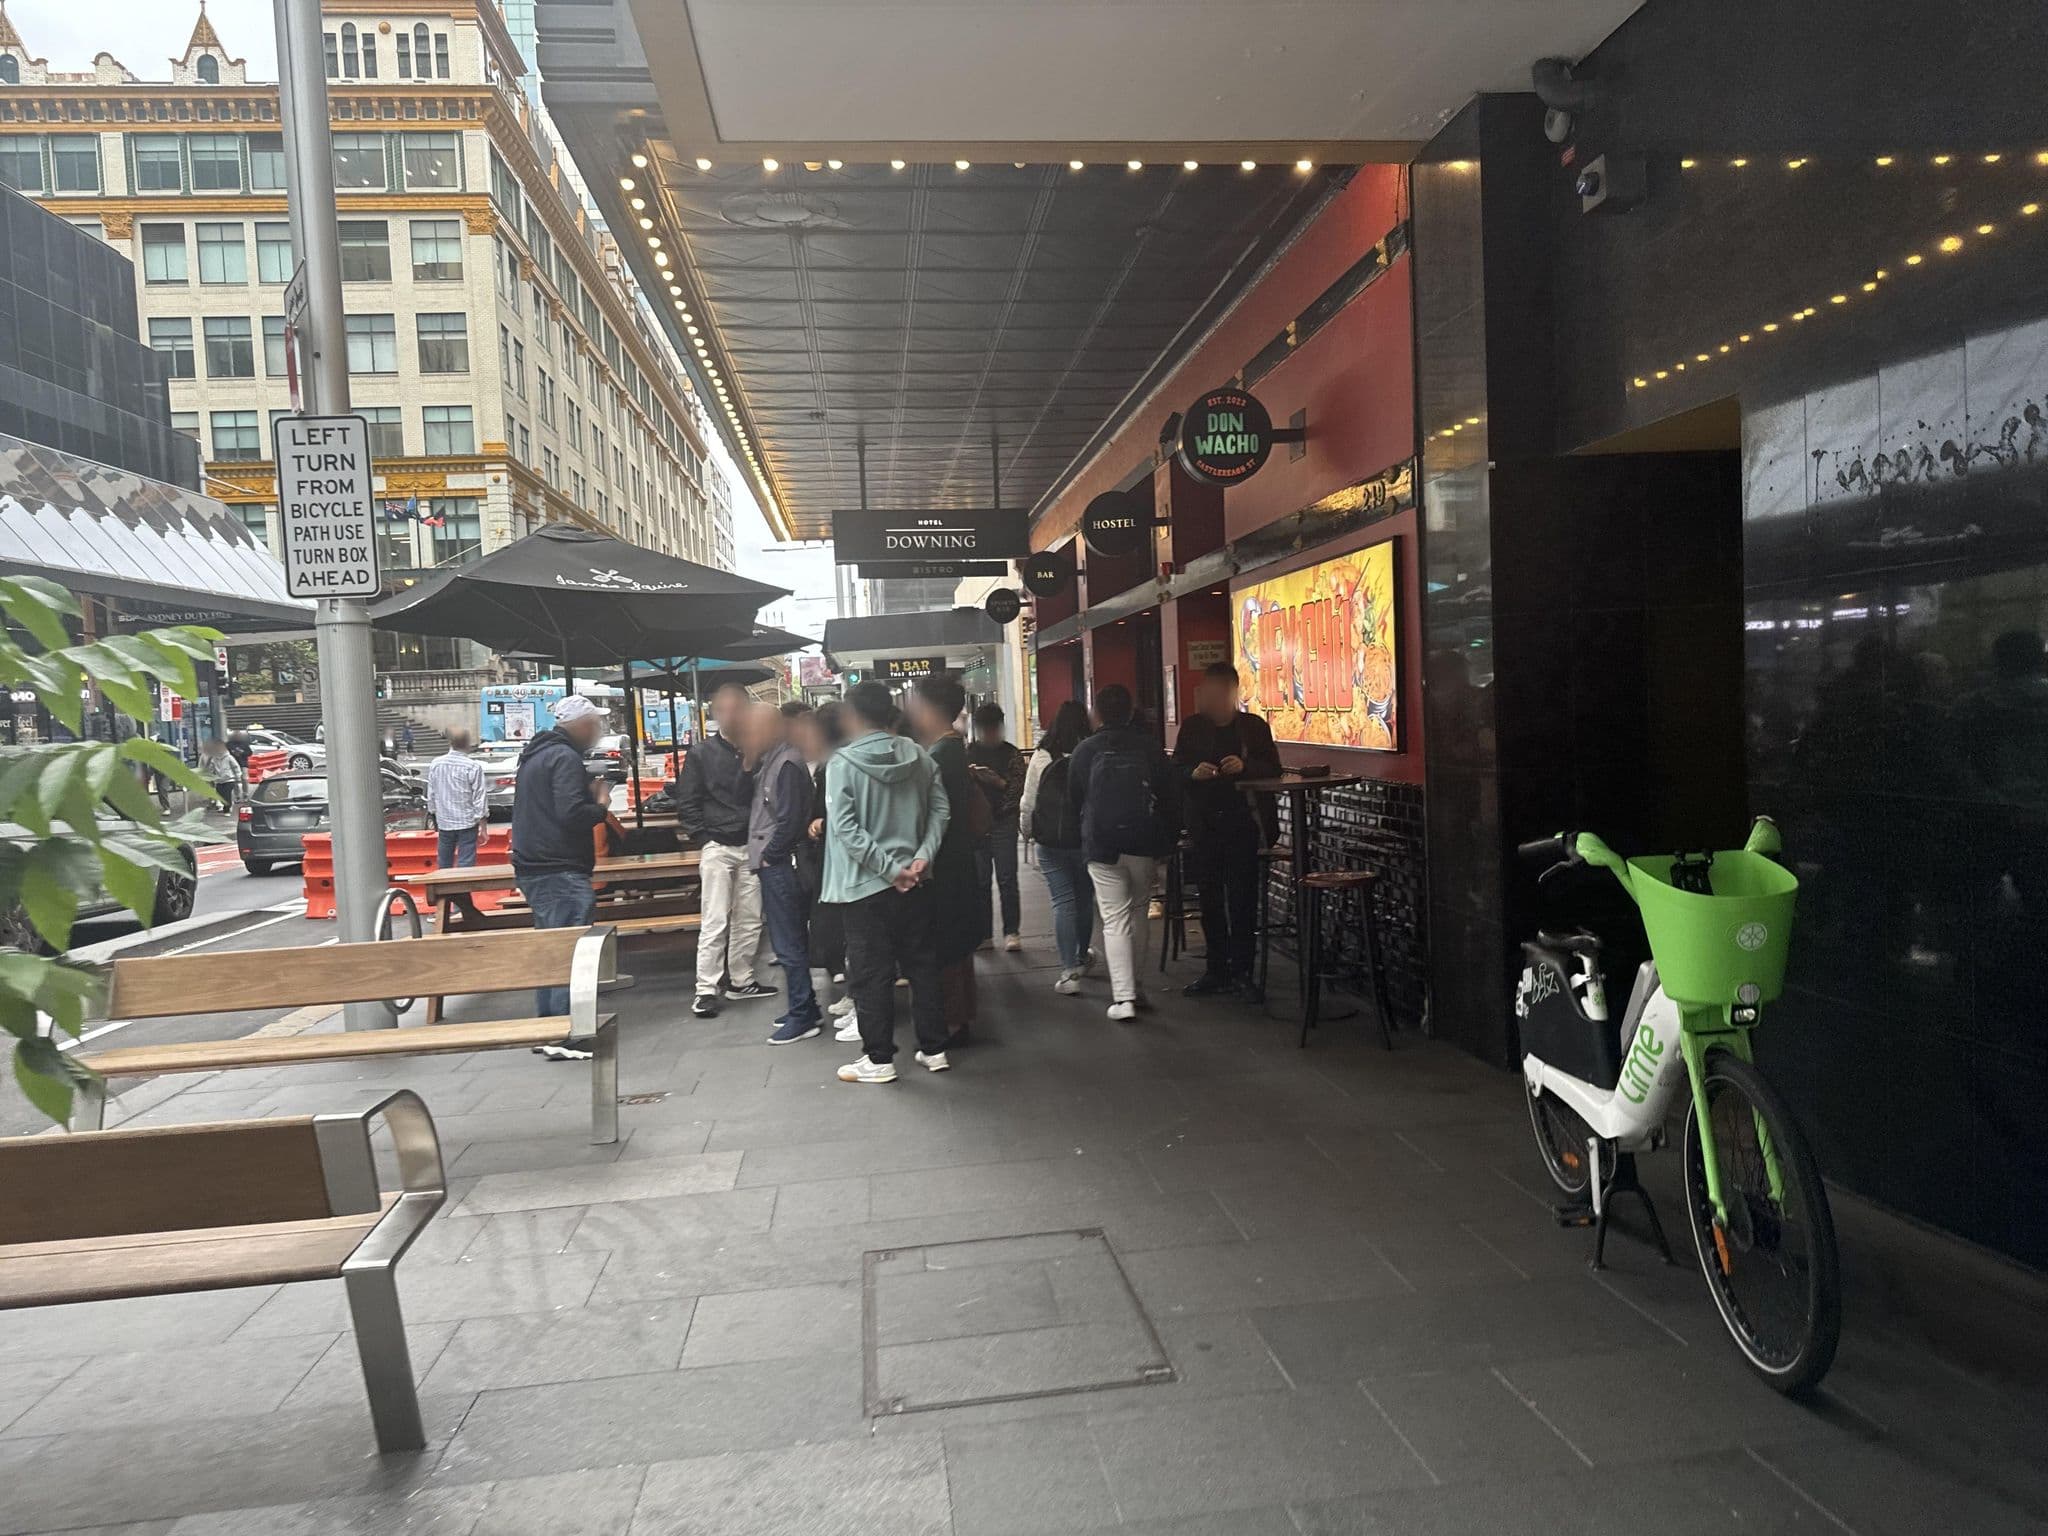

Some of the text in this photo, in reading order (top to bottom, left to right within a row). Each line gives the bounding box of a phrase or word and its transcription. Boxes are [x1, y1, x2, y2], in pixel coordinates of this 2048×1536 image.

[1207, 412, 1244, 433] DON
[291, 427, 351, 446] LEFT
[1195, 434, 1259, 455] WACHO
[292, 453, 356, 472] TURN
[297, 479, 355, 496] FROM
[291, 501, 364, 519] BICYCLE
[294, 524, 365, 542] PATH USE
[1092, 518, 1137, 530] HOSTEL
[886, 535, 977, 549] DOWNING
[293, 547, 368, 565] TURN BOX
[296, 569, 370, 587] AHEAD
[913, 566, 954, 574] BISTRO
[1036, 571, 1055, 579] BAR
[147, 612, 182, 621] SYDNEY
[185, 610, 209, 620] DUTY
[889, 660, 930, 672] M BAR
[1258, 605, 1297, 712] HEY
